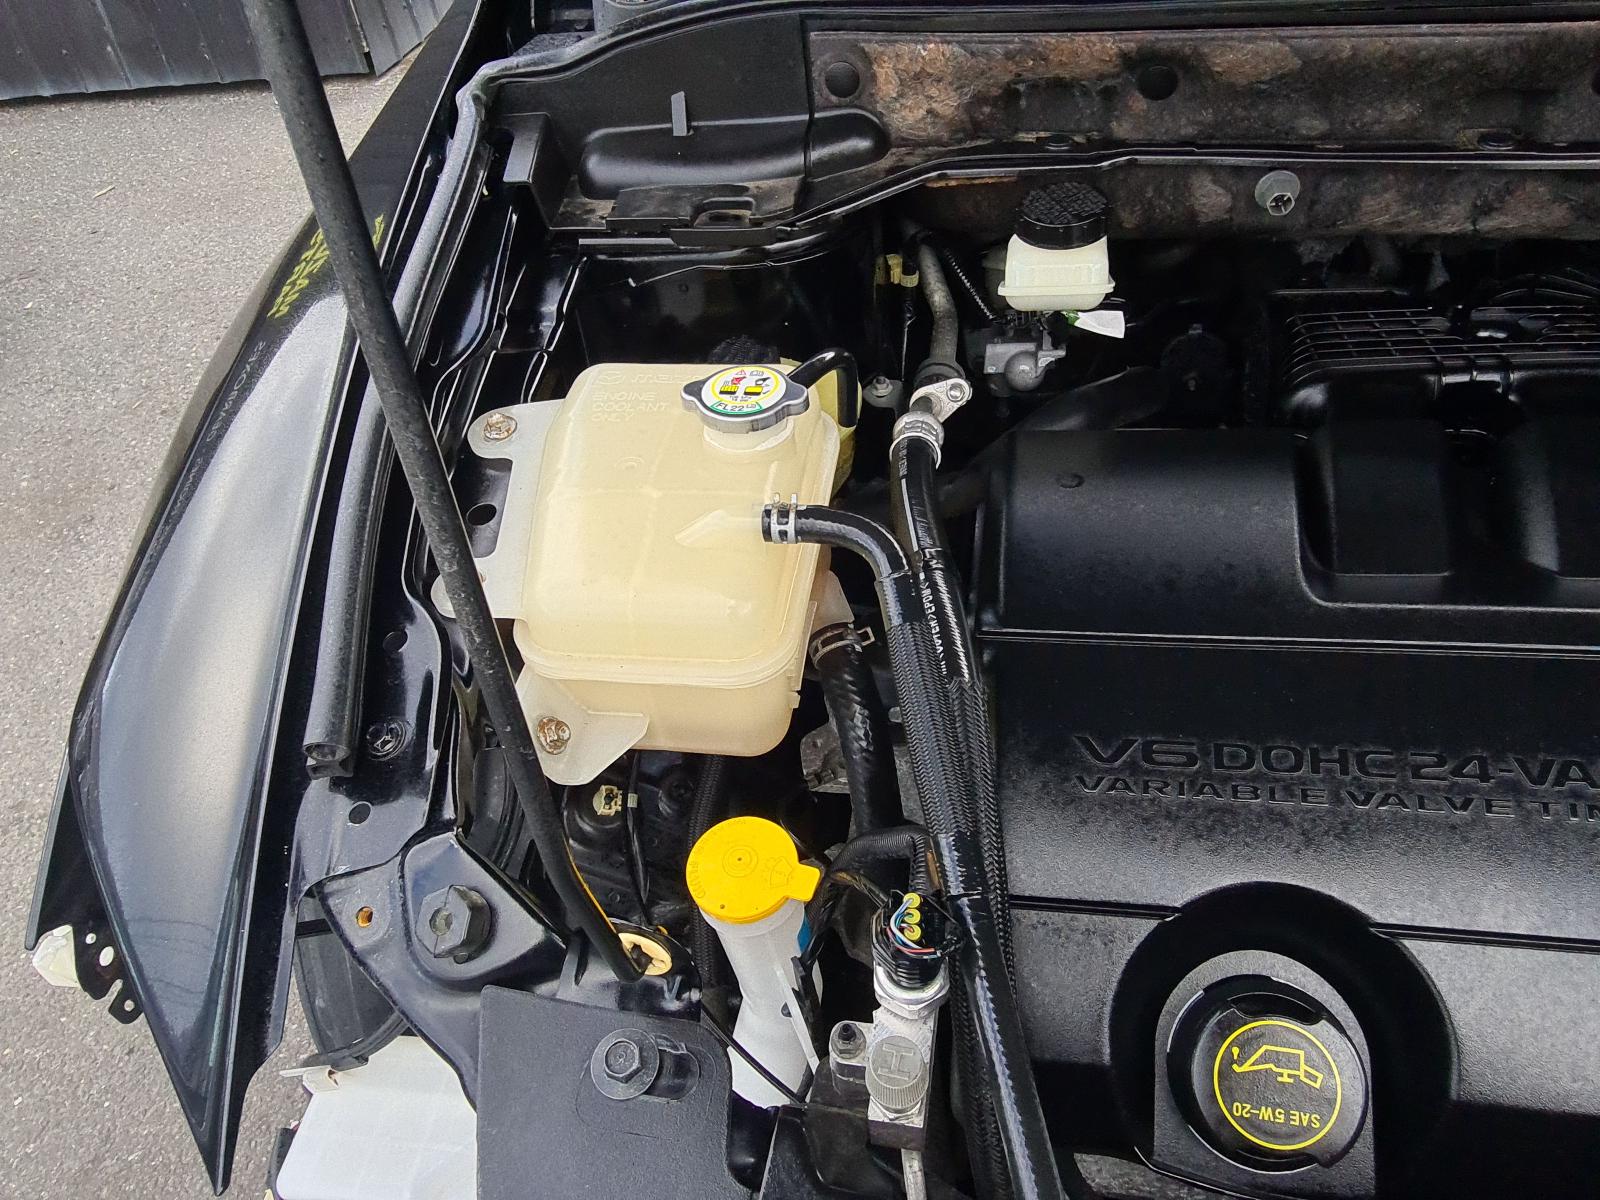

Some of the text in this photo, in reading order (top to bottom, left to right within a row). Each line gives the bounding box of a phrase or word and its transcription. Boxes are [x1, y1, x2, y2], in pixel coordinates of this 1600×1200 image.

[592, 391, 657, 401] ENGINE
[593, 401, 670, 413] COOLANT
[1073, 735, 1200, 770] V6
[1211, 741, 1398, 783] DOHC
[1074, 774, 1330, 806] VARIABLE
[1344, 788, 1516, 818] VALVE
[1232, 1101, 1321, 1129] SAE 5W-20
